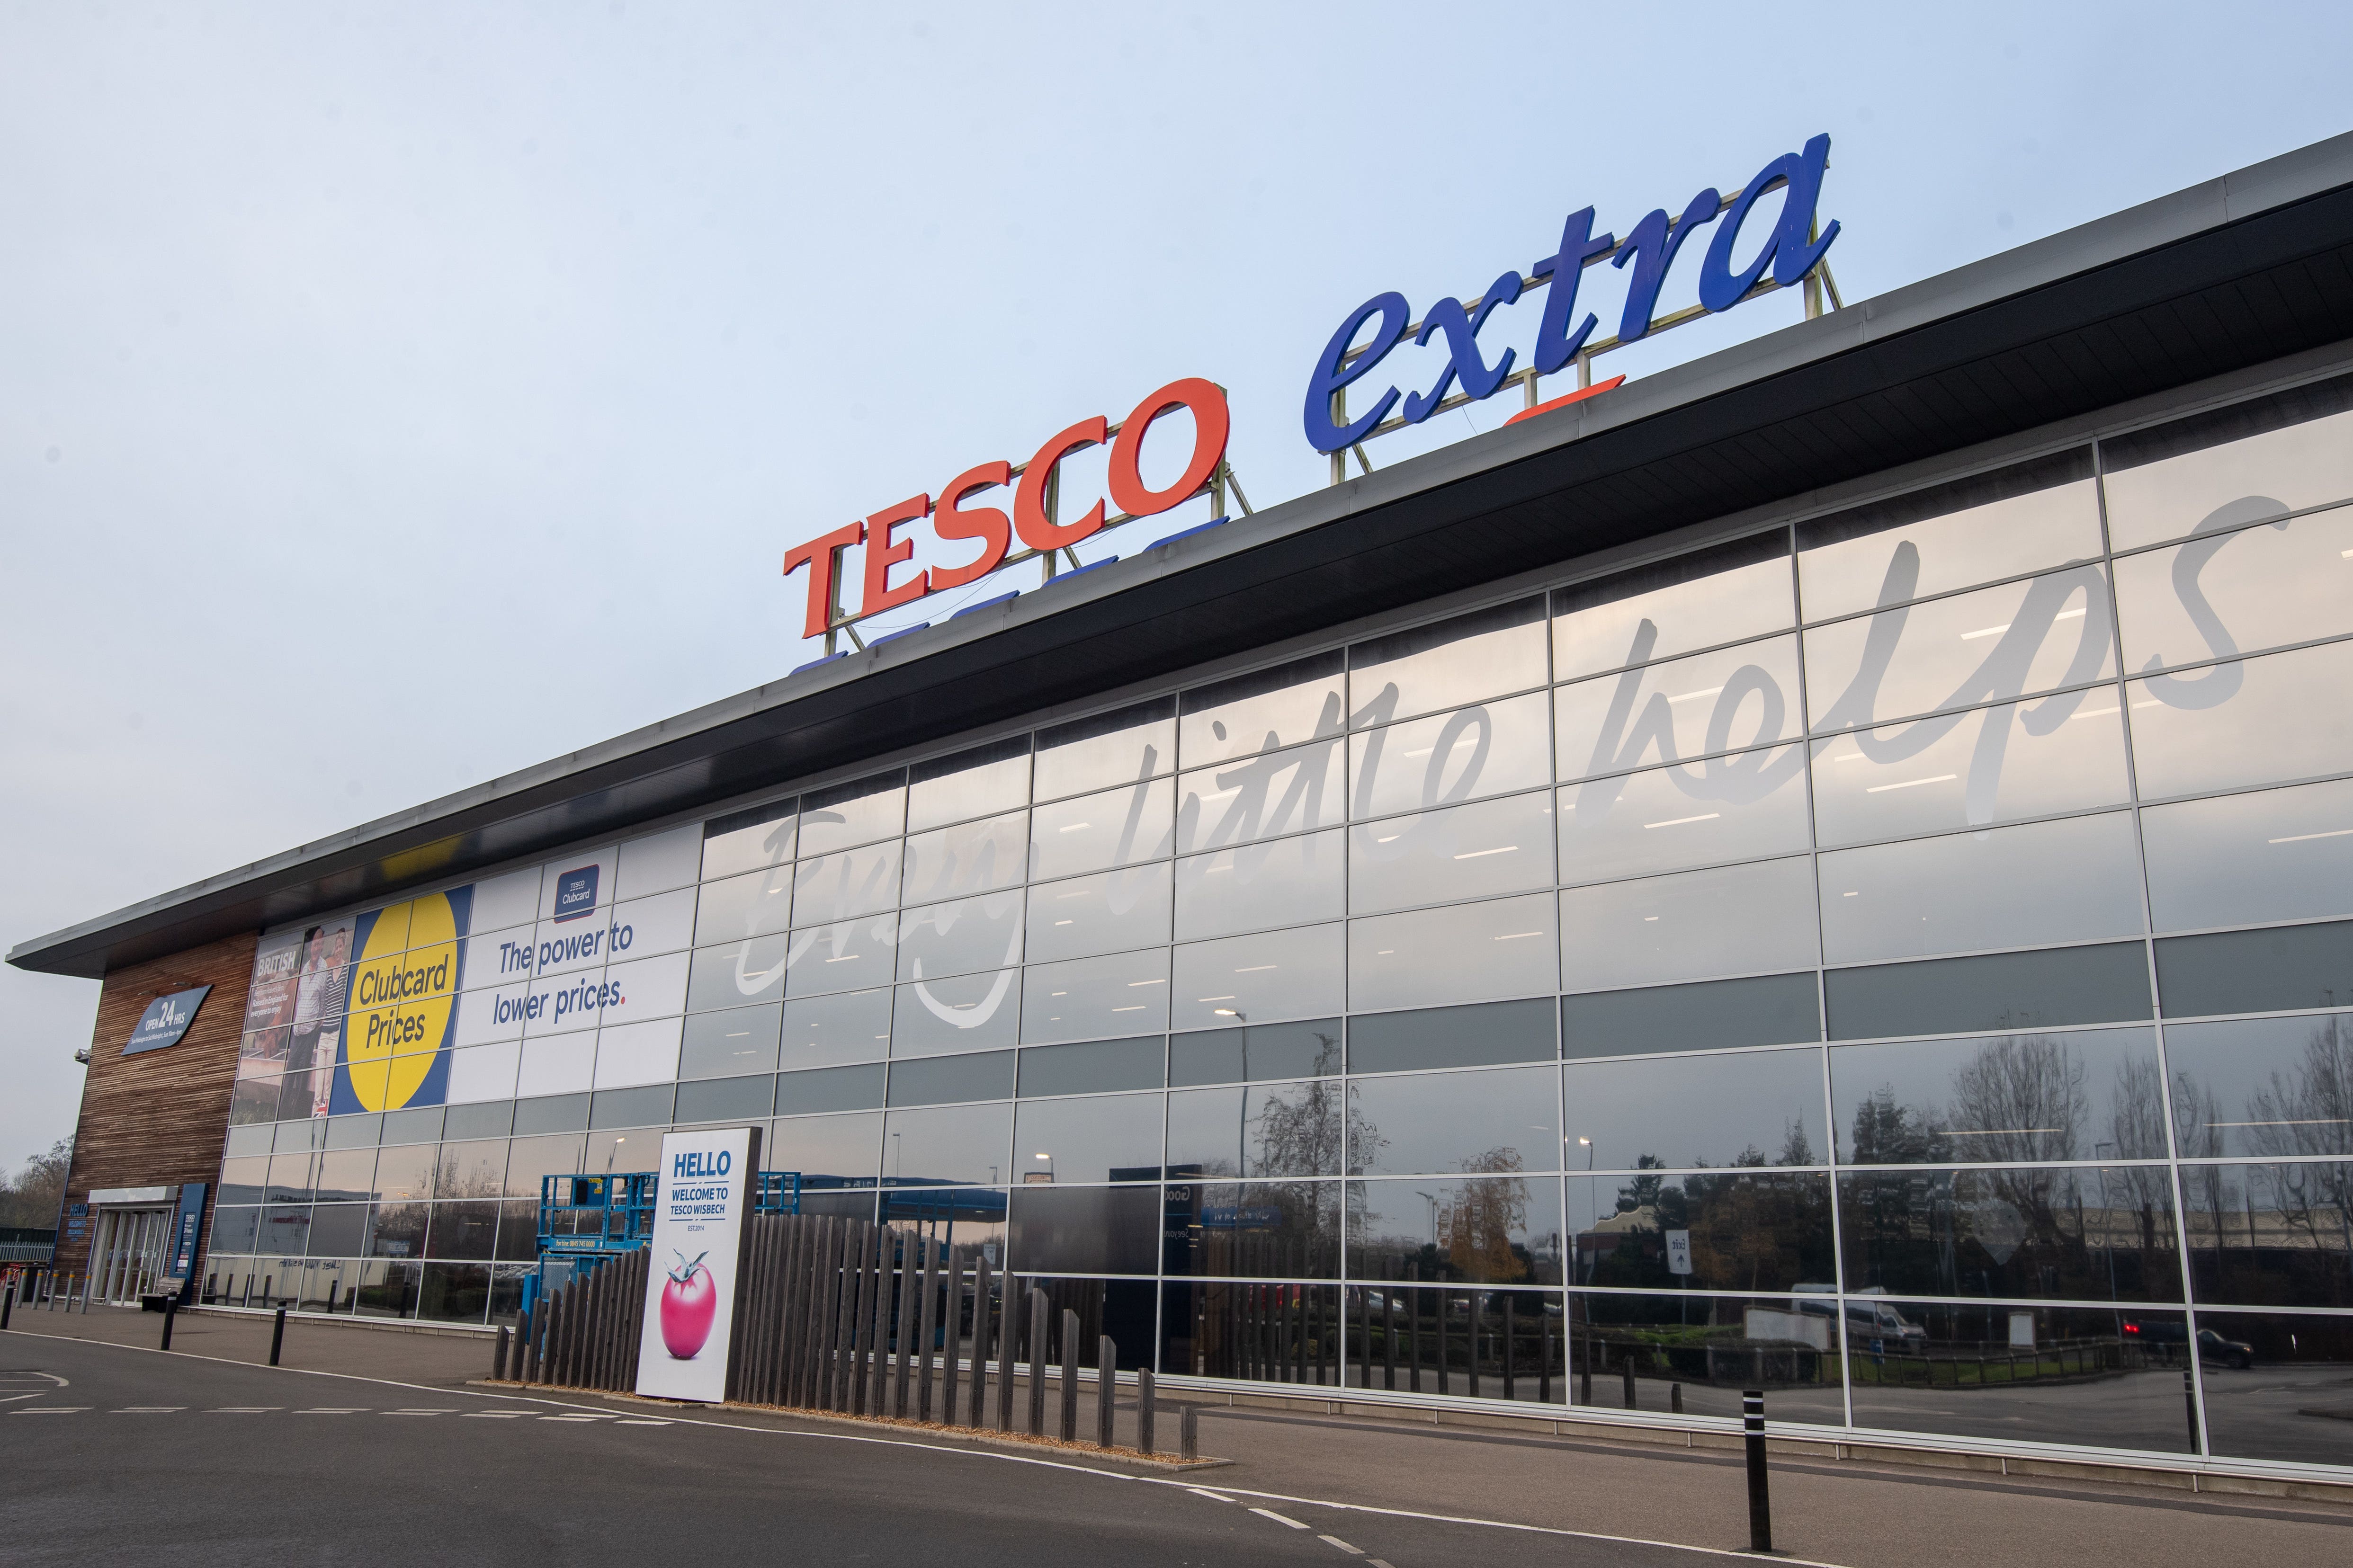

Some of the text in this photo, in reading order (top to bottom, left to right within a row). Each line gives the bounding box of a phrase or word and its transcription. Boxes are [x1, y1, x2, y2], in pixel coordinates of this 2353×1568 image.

[783, 133, 1841, 639] TESCO extra
[735, 495, 2292, 1028] Every little helps
[563, 888, 590, 904] Clubcard
[570, 880, 585, 890] TESCO
[500, 920, 633, 975] The power to
[257, 951, 296, 977] BRITISH
[359, 953, 449, 1005] Clubcard
[251, 1009, 267, 1017] everyone
[271, 1005, 282, 1014] enjoy
[253, 998, 264, 1007] Raised
[268, 994, 283, 1005] England
[493, 977, 626, 1025] lower prices.
[145, 1000, 186, 1031] OPEN 24 HRS
[366, 1009, 426, 1049] Prices
[673, 1150, 731, 1177] HELLO
[672, 1187, 728, 1201] WELCOME TO
[70, 1204, 88, 1216] HELLO
[671, 1204, 725, 1215] TESCO WISBECH
